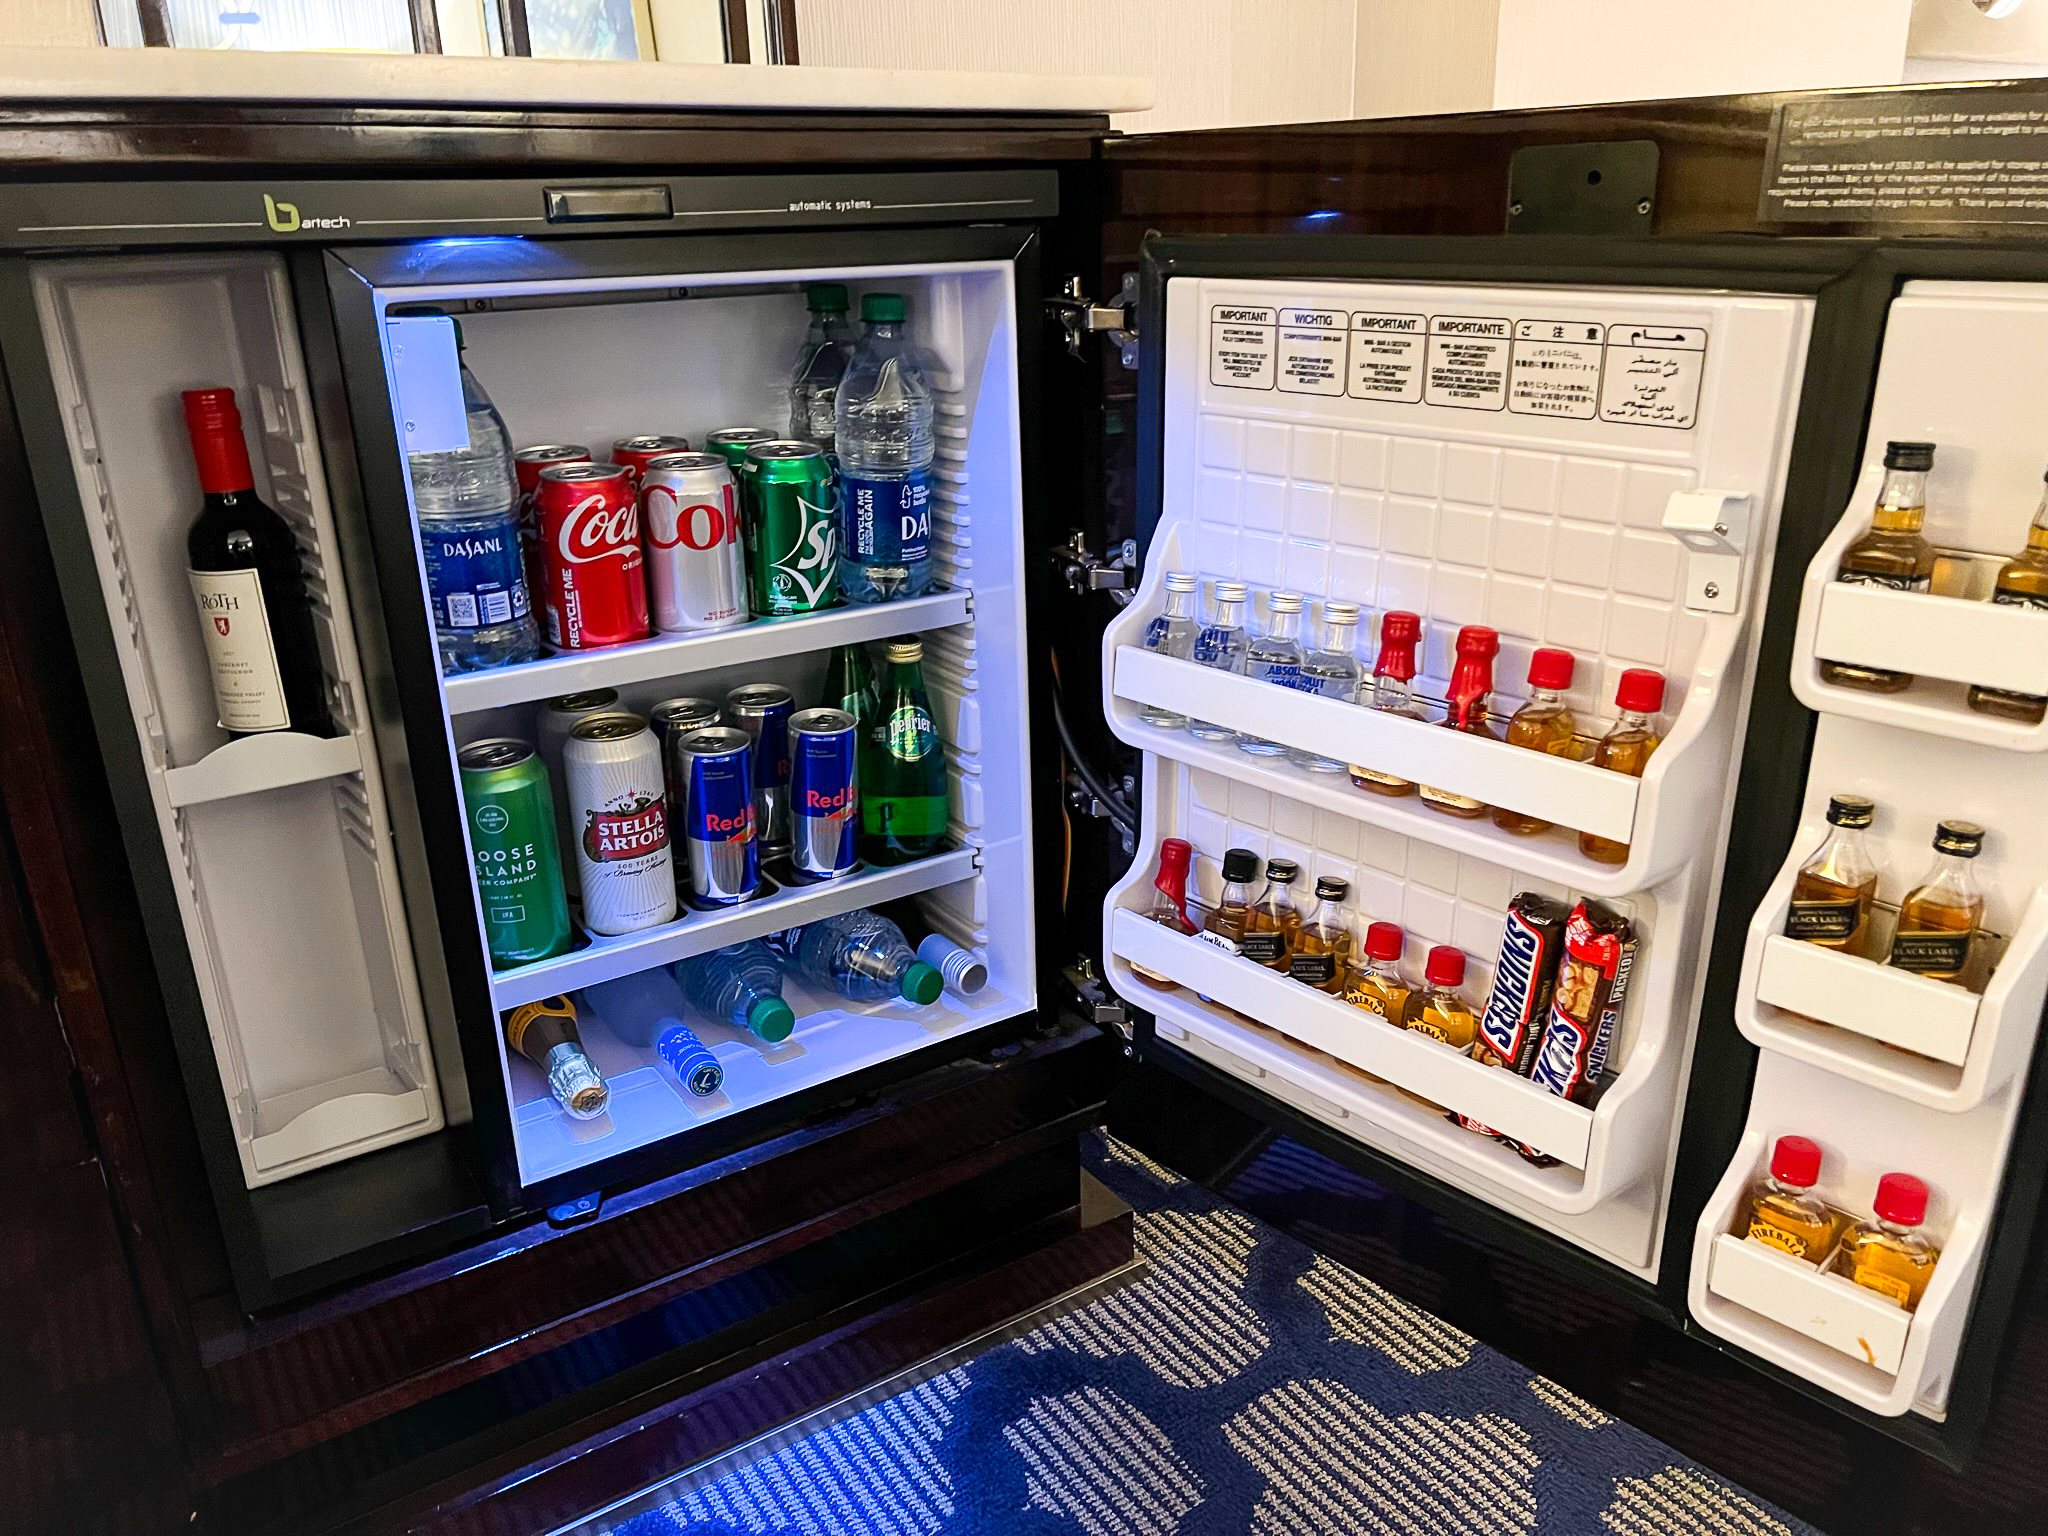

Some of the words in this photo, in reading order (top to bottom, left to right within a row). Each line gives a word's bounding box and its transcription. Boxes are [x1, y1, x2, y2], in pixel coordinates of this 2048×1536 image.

[789, 200, 832, 212] automatic
[835, 199, 871, 212] systems
[1220, 310, 1268, 322] IMPORTANT
[1295, 313, 1333, 326] WICHTIG
[1361, 317, 1417, 330] IMPORTANT
[1438, 321, 1505, 335] IMPORTANTE
[857, 488, 865, 505] ME
[864, 489, 873, 529] AGAIN
[857, 508, 865, 554] RECYCLE
[443, 538, 503, 559] DASANI
[562, 568, 574, 589] ME
[565, 591, 580, 647] RECYCLE
[807, 788, 844, 808] Red
[599, 811, 663, 836] STELLA
[706, 809, 745, 832] Red
[600, 823, 665, 851] ARTOIS
[478, 843, 534, 863] OOSE
[476, 859, 536, 878] SLAND
[493, 873, 535, 887] COMPANY
[1612, 958, 1632, 999] PACKED
[1585, 1010, 1616, 1083] SNICKERS
